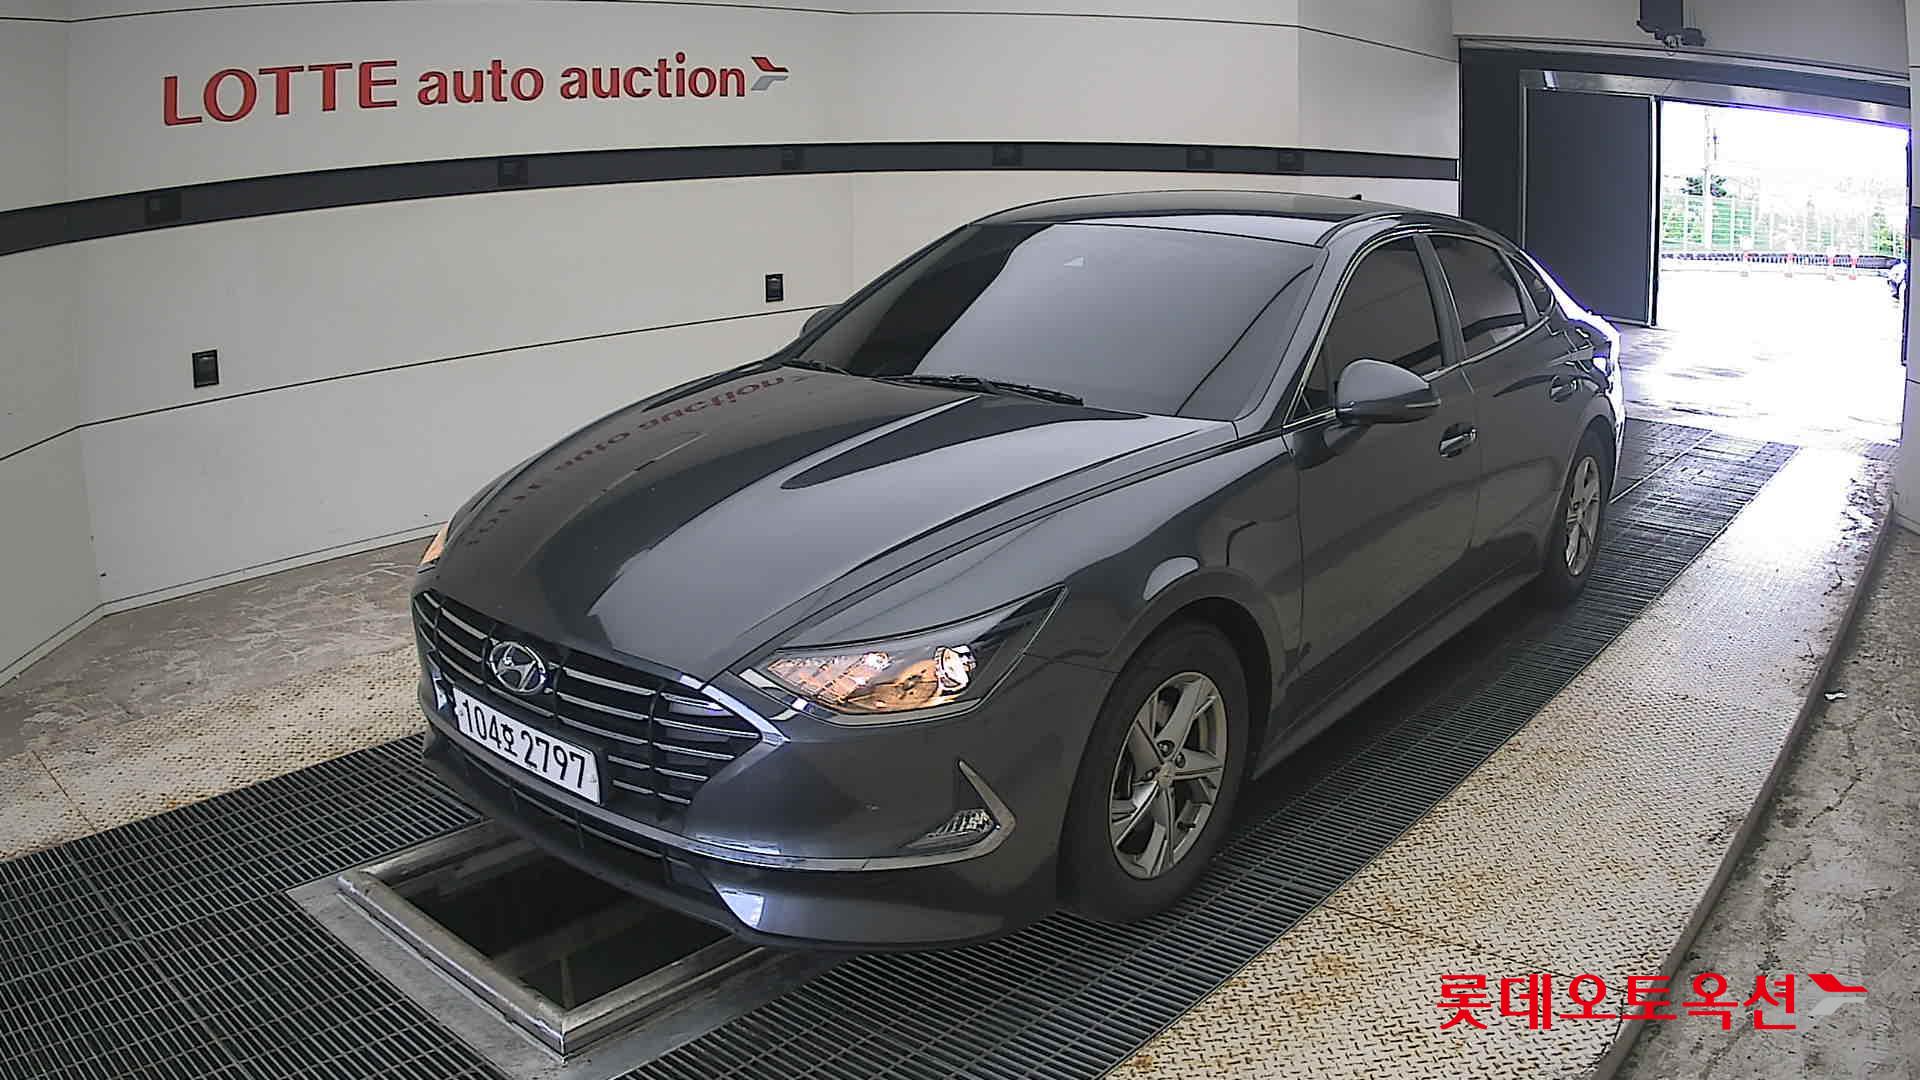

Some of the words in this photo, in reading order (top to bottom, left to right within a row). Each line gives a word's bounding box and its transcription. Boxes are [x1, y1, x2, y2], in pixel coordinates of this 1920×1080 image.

[162, 58, 398, 127] LOTTE
[416, 59, 545, 106] auto
[559, 51, 747, 99] auction
